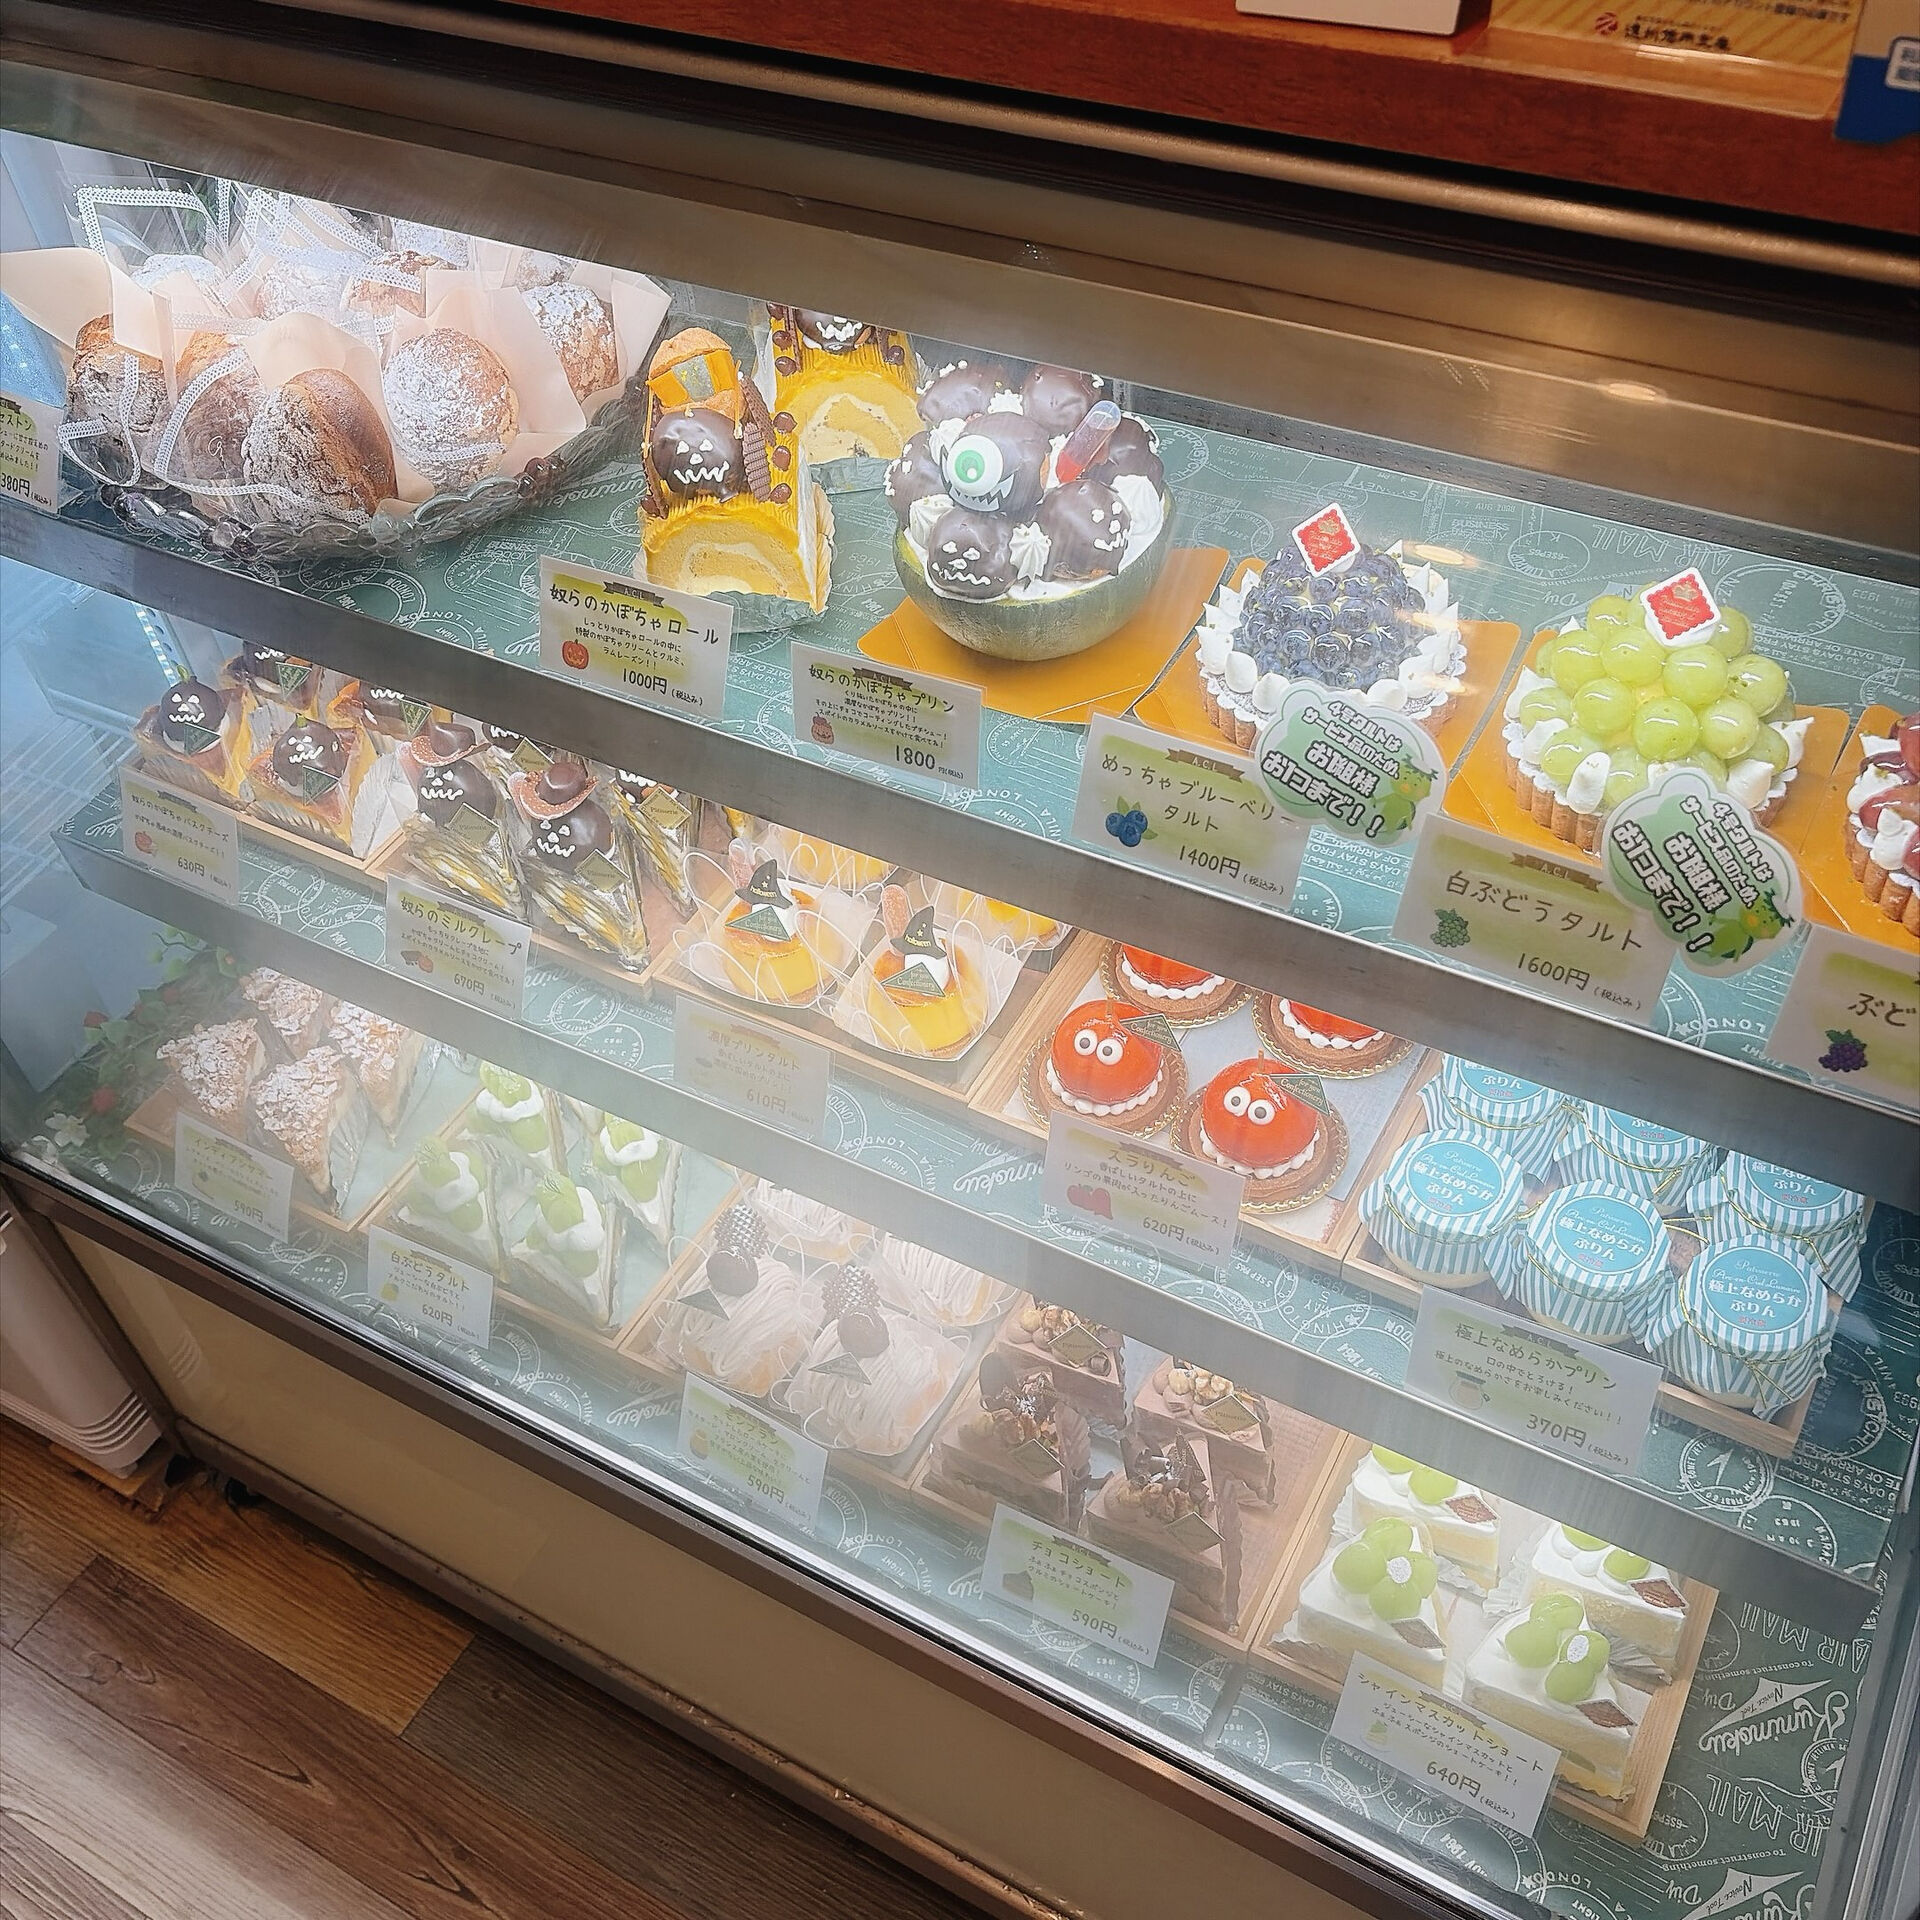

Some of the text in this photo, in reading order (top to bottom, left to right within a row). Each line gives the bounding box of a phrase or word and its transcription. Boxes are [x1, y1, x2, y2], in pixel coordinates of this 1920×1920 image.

[1, 472, 30, 497] 380円
[550, 583, 719, 645] 奴らのかぼちゃロール
[584, 617, 682, 653] しっとりかぼちゃロールの中に
[623, 668, 668, 695] 1000円
[808, 664, 955, 713] 奴らのかぼちゃプリン
[1302, 706, 1400, 780] サービス品のため、
[1328, 700, 1403, 753] 4号タルトは
[896, 745, 935, 770] 1800
[1102, 753, 1296, 824] めっちゃブルーベリー
[1164, 804, 1219, 833] タルト
[1680, 795, 1760, 908] サービス品のため、
[1713, 802, 1774, 884] 4号タルトは
[177, 857, 205, 877] 630円
[1179, 845, 1284, 896] 1400円 (税込み)
[400, 897, 522, 955] 奴らのミルクレープ
[1446, 869, 1643, 951] 白ぶどうタルト
[454, 973, 485, 996] 670円
[1518, 953, 1641, 1011] 1600円 (税込み)
[1108, 1150, 1195, 1187] スラりんご
[1413, 1160, 1495, 1202] 極上なめらか
[1142, 1216, 1185, 1242] 620円
[1558, 1216, 1645, 1256] 極上なめらか
[391, 1250, 471, 1292] 白ぶどうタルト
[1708, 1279, 1802, 1308] 極上なめらか
[421, 1303, 453, 1328] 620円
[1455, 1322, 1618, 1391] 極上なめらかプリン
[1526, 1413, 1587, 1449] 370円
[747, 1473, 785, 1505] 590円
[1031, 1540, 1126, 1588] チョコショート
[1071, 1608, 1118, 1639] 590円
[1357, 1672, 1544, 1772] シャインマスカットショート
[1426, 1760, 1482, 1799] 640円
